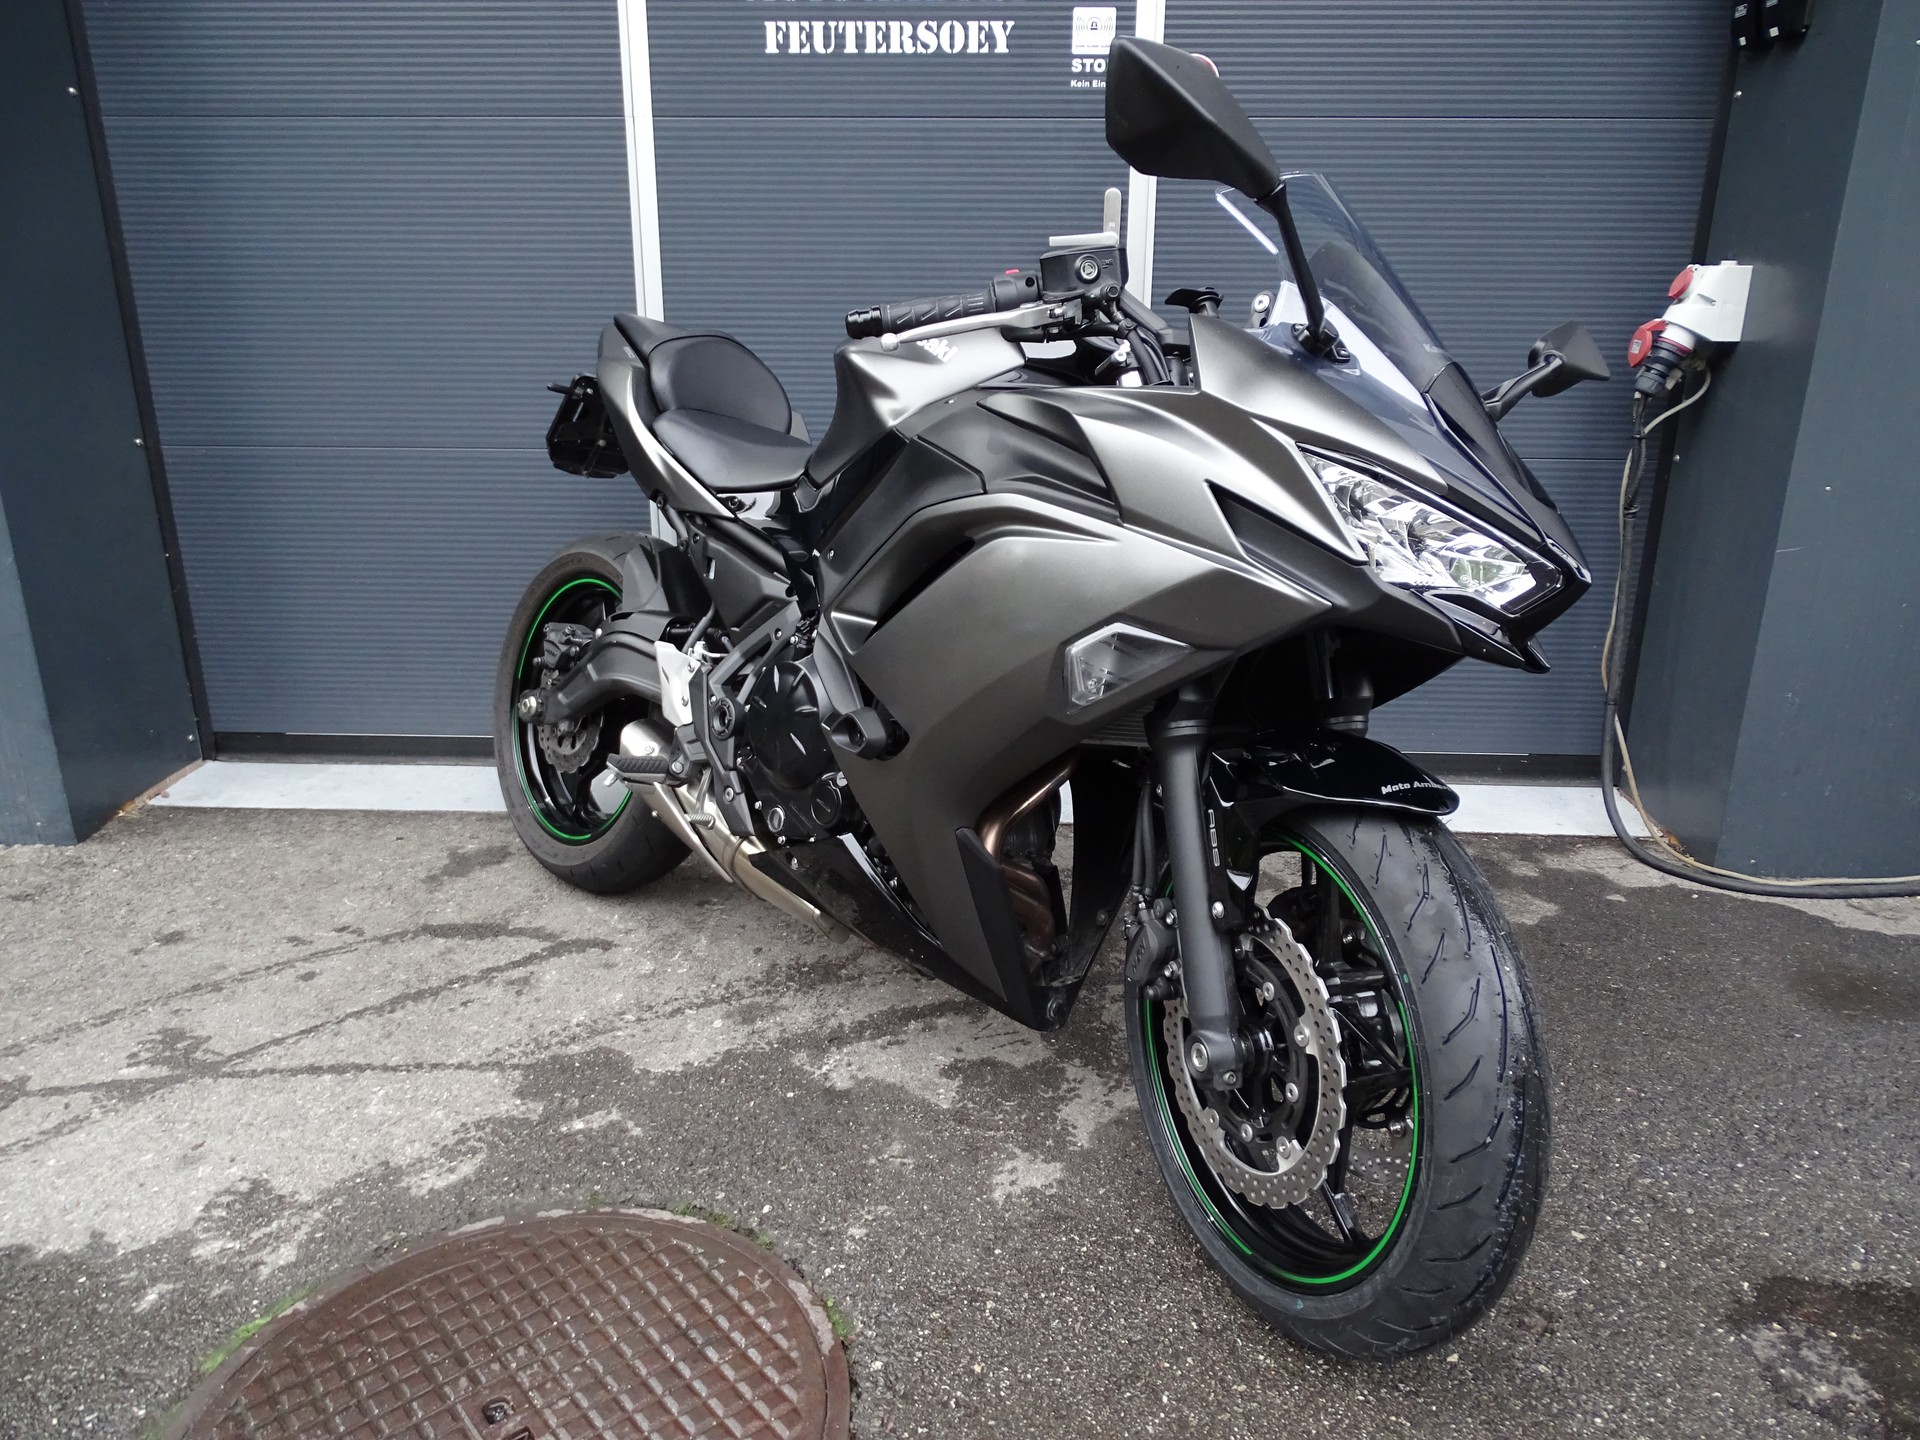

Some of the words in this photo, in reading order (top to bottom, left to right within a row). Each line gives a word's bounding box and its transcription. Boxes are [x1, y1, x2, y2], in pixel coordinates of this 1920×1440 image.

[764, 20, 1015, 55] FEUTERSOEY
[1071, 58, 1109, 73] STO
[1070, 79, 1090, 88] Kein
[1381, 782, 1411, 795] Moto
[1208, 809, 1220, 867] ABS
